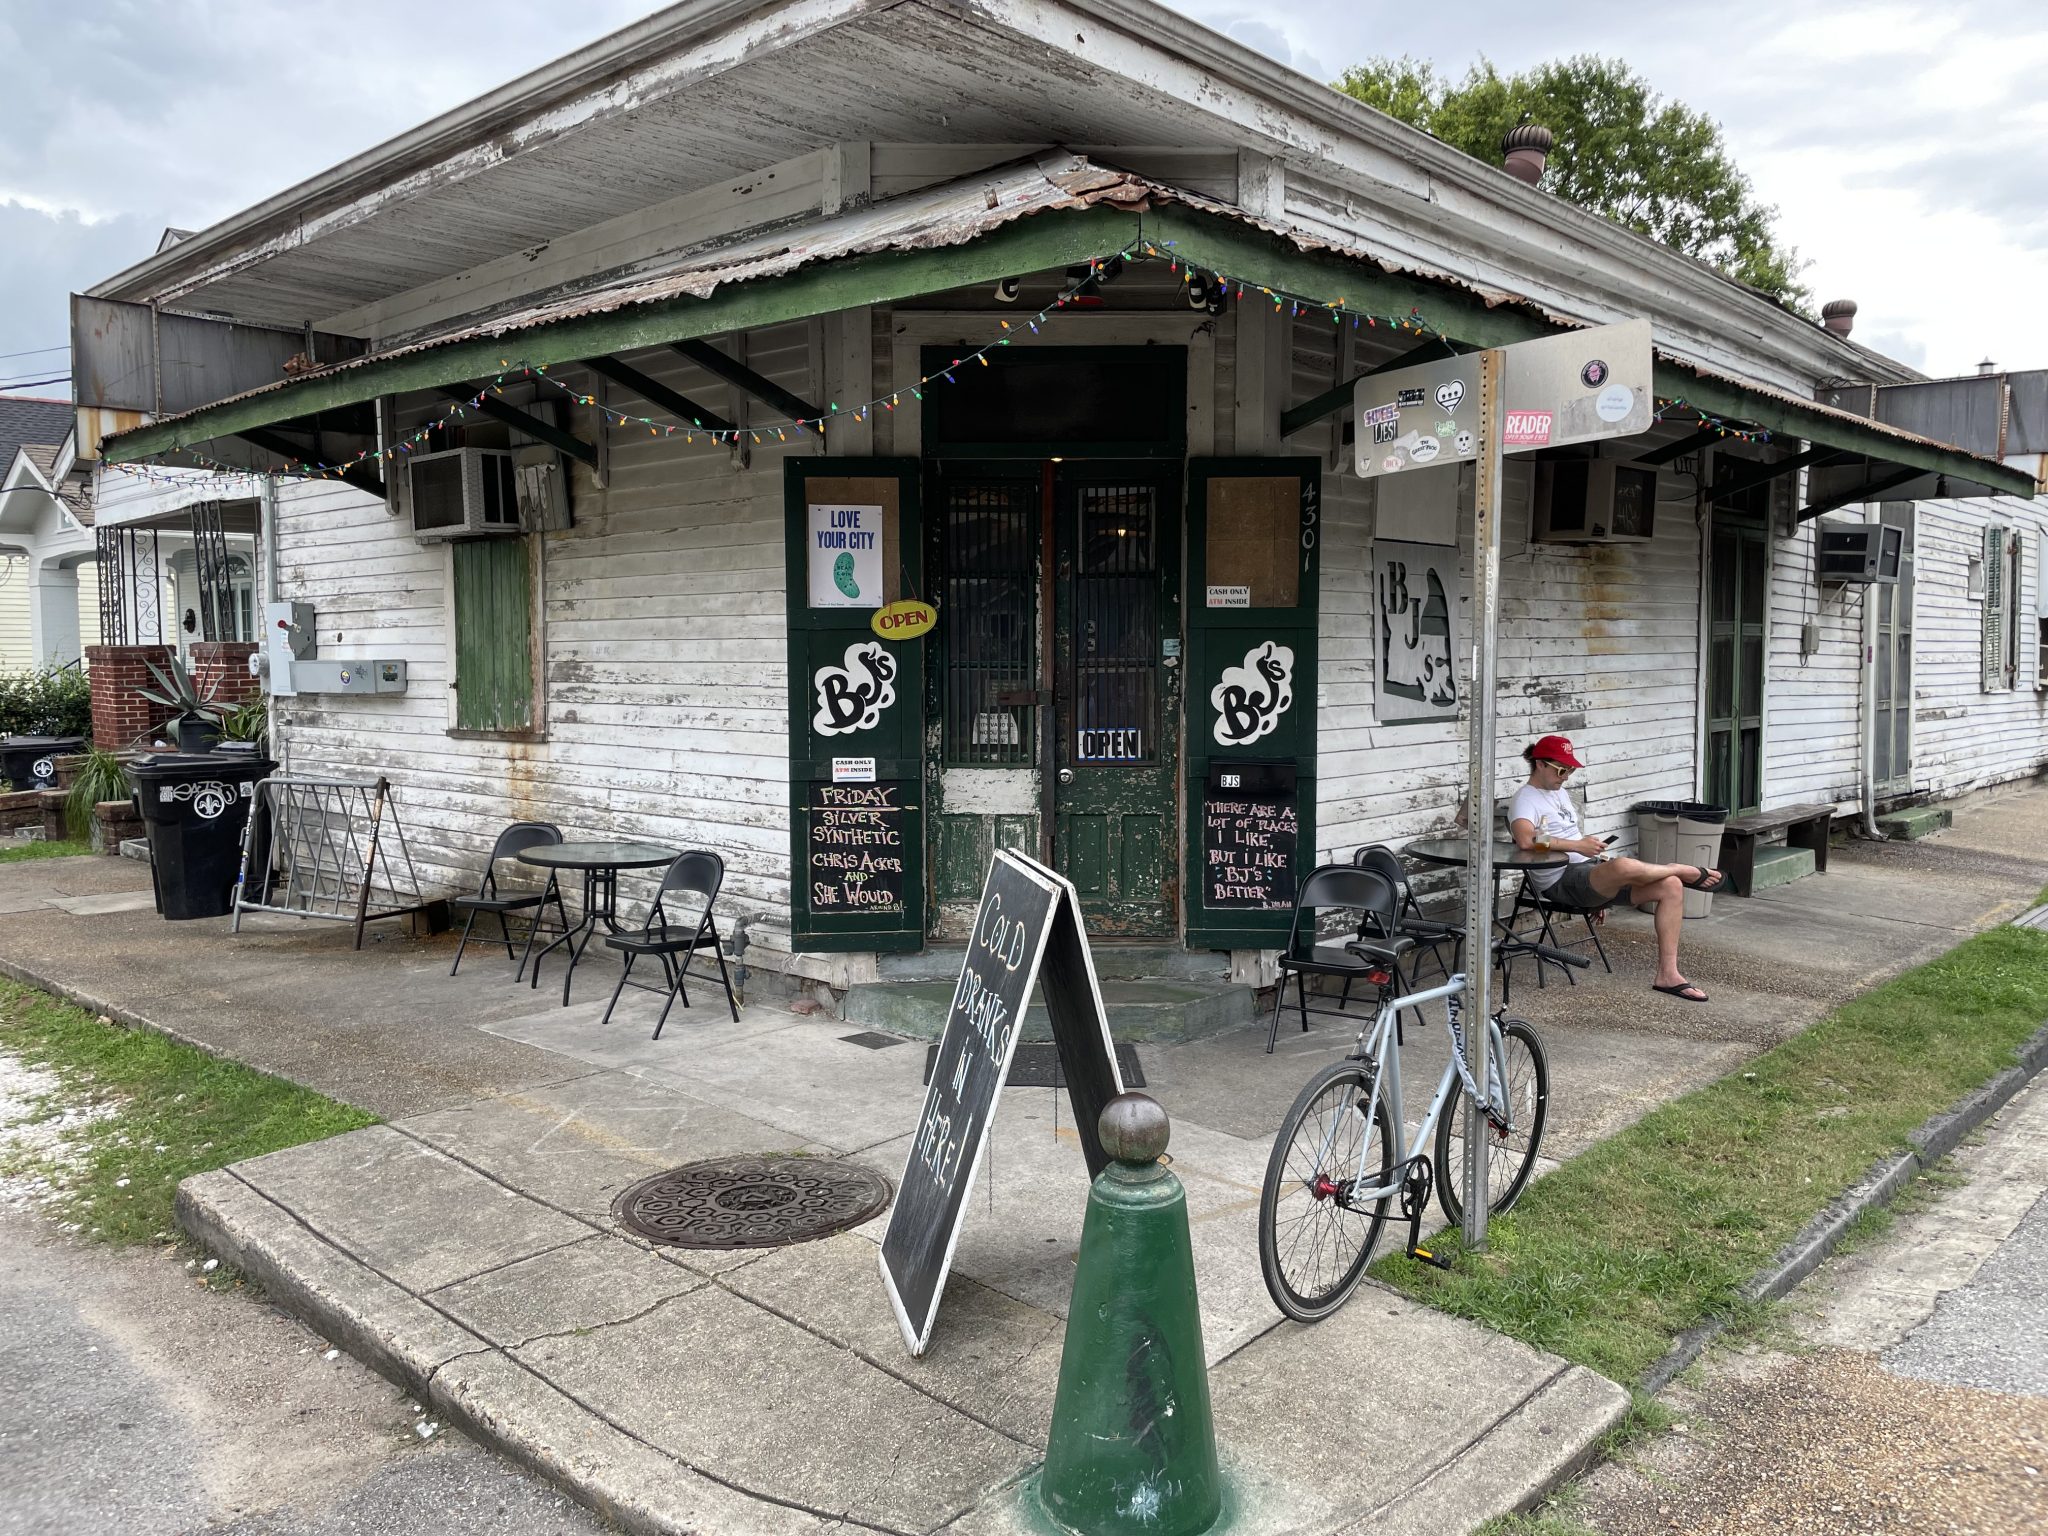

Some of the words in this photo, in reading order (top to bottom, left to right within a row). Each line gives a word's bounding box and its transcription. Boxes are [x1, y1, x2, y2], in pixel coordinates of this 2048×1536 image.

[1506, 416, 1551, 434] READER
[831, 511, 861, 529] LOVE
[1302, 482, 1317, 573] 4301
[817, 531, 846, 549] YOUR
[849, 532, 875, 550] CITY
[880, 610, 929, 629] OPEN
[1083, 732, 1137, 758] OPEN
[1222, 775, 1239, 787] BJS
[820, 786, 897, 806] FRIDAY
[822, 811, 890, 828] SILVER
[1249, 803, 1277, 818] ARE
[1280, 806, 1296, 820] A
[1207, 816, 1231, 829] LOT
[1235, 817, 1253, 828] OF
[1256, 819, 1298, 834] PLACES
[812, 826, 901, 846] SYNTHETIC
[812, 852, 859, 870] CHRIS
[858, 850, 903, 873] ACKER
[1208, 849, 1237, 866] BUT
[1254, 849, 1287, 868] LIKE
[812, 881, 840, 906] SHE
[842, 881, 894, 906] WOULD
[980, 892, 1026, 972] COLD
[957, 966, 1011, 1067] DRANKS
